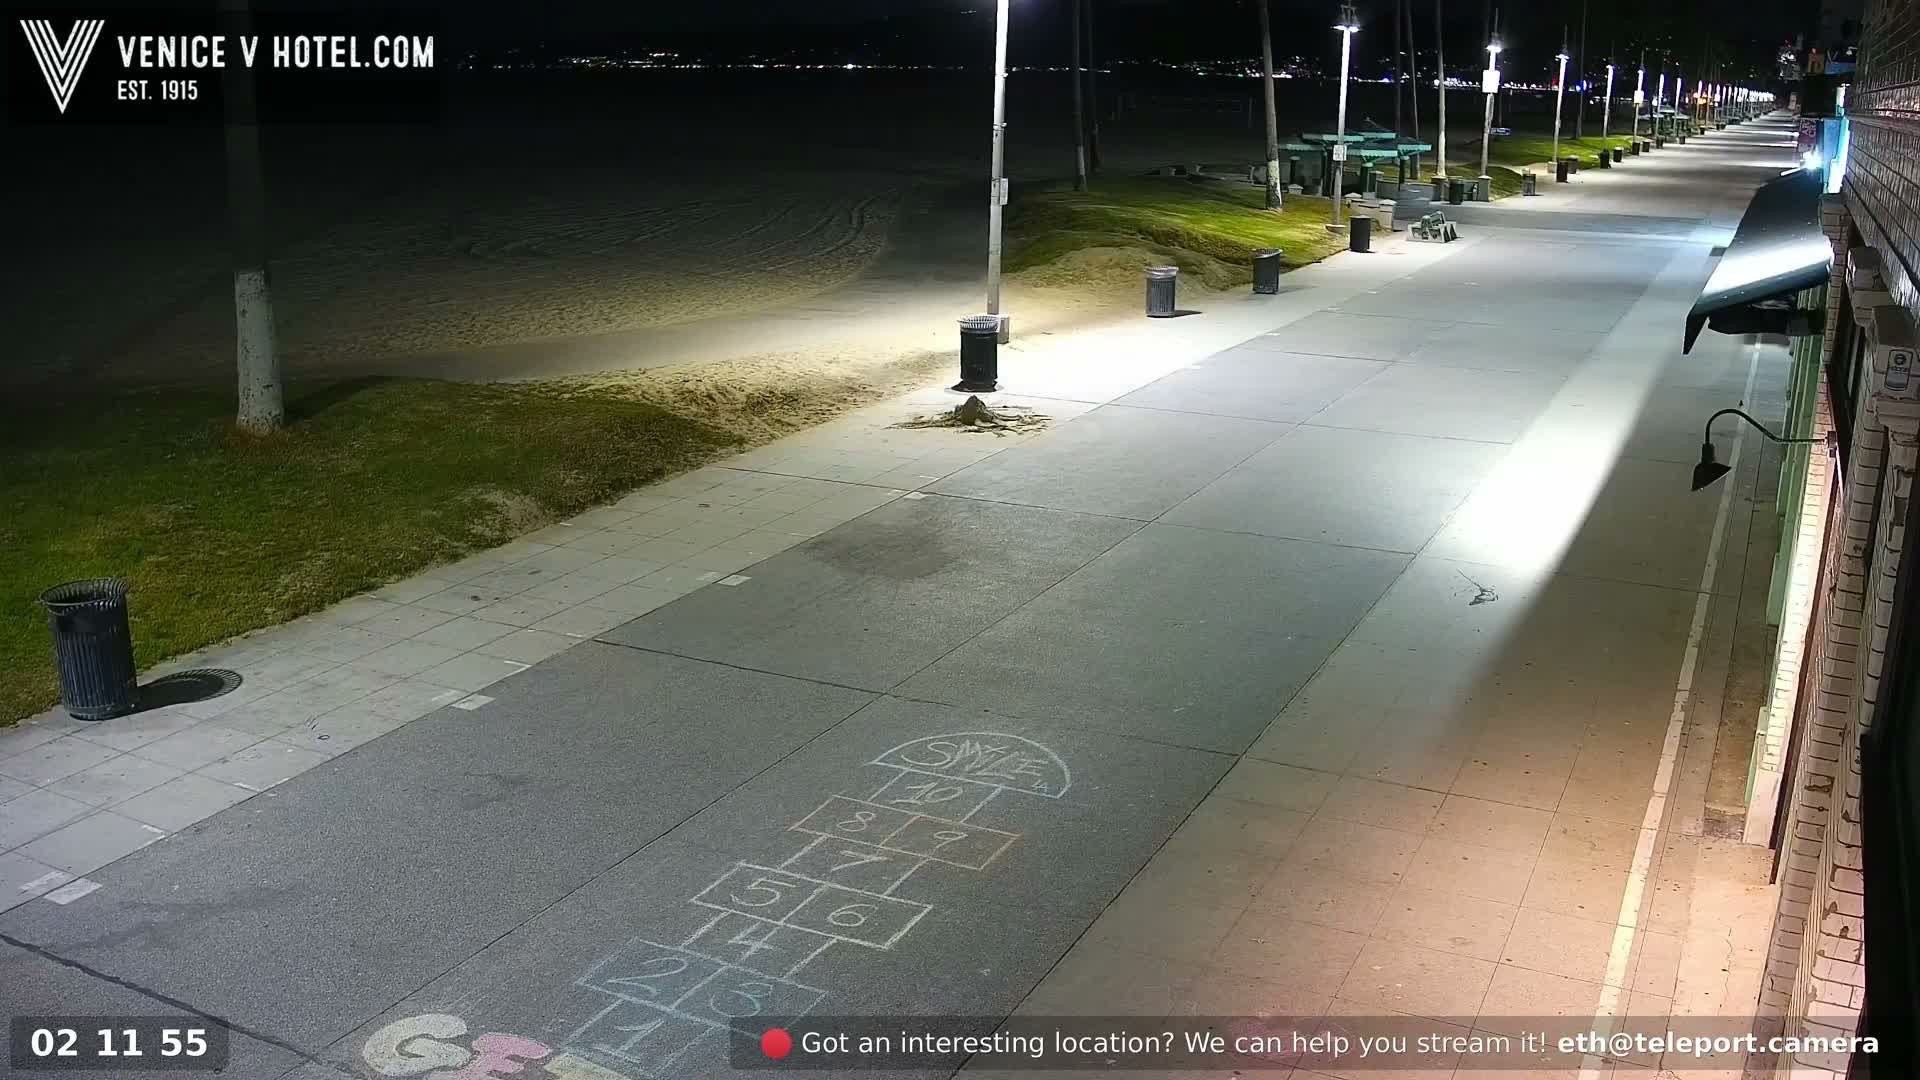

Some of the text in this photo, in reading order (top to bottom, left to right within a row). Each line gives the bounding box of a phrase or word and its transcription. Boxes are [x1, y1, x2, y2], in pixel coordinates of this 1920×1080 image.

[900, 739, 1048, 780] SMILE
[891, 782, 963, 804] 10
[836, 811, 876, 832] 8
[934, 830, 968, 849] 9
[831, 849, 893, 872] 7
[730, 877, 797, 907] 5
[827, 903, 879, 927] 6
[728, 920, 779, 961] 4
[604, 956, 689, 996] 2
[710, 981, 774, 1018] 3
[592, 1018, 664, 1064] 1
